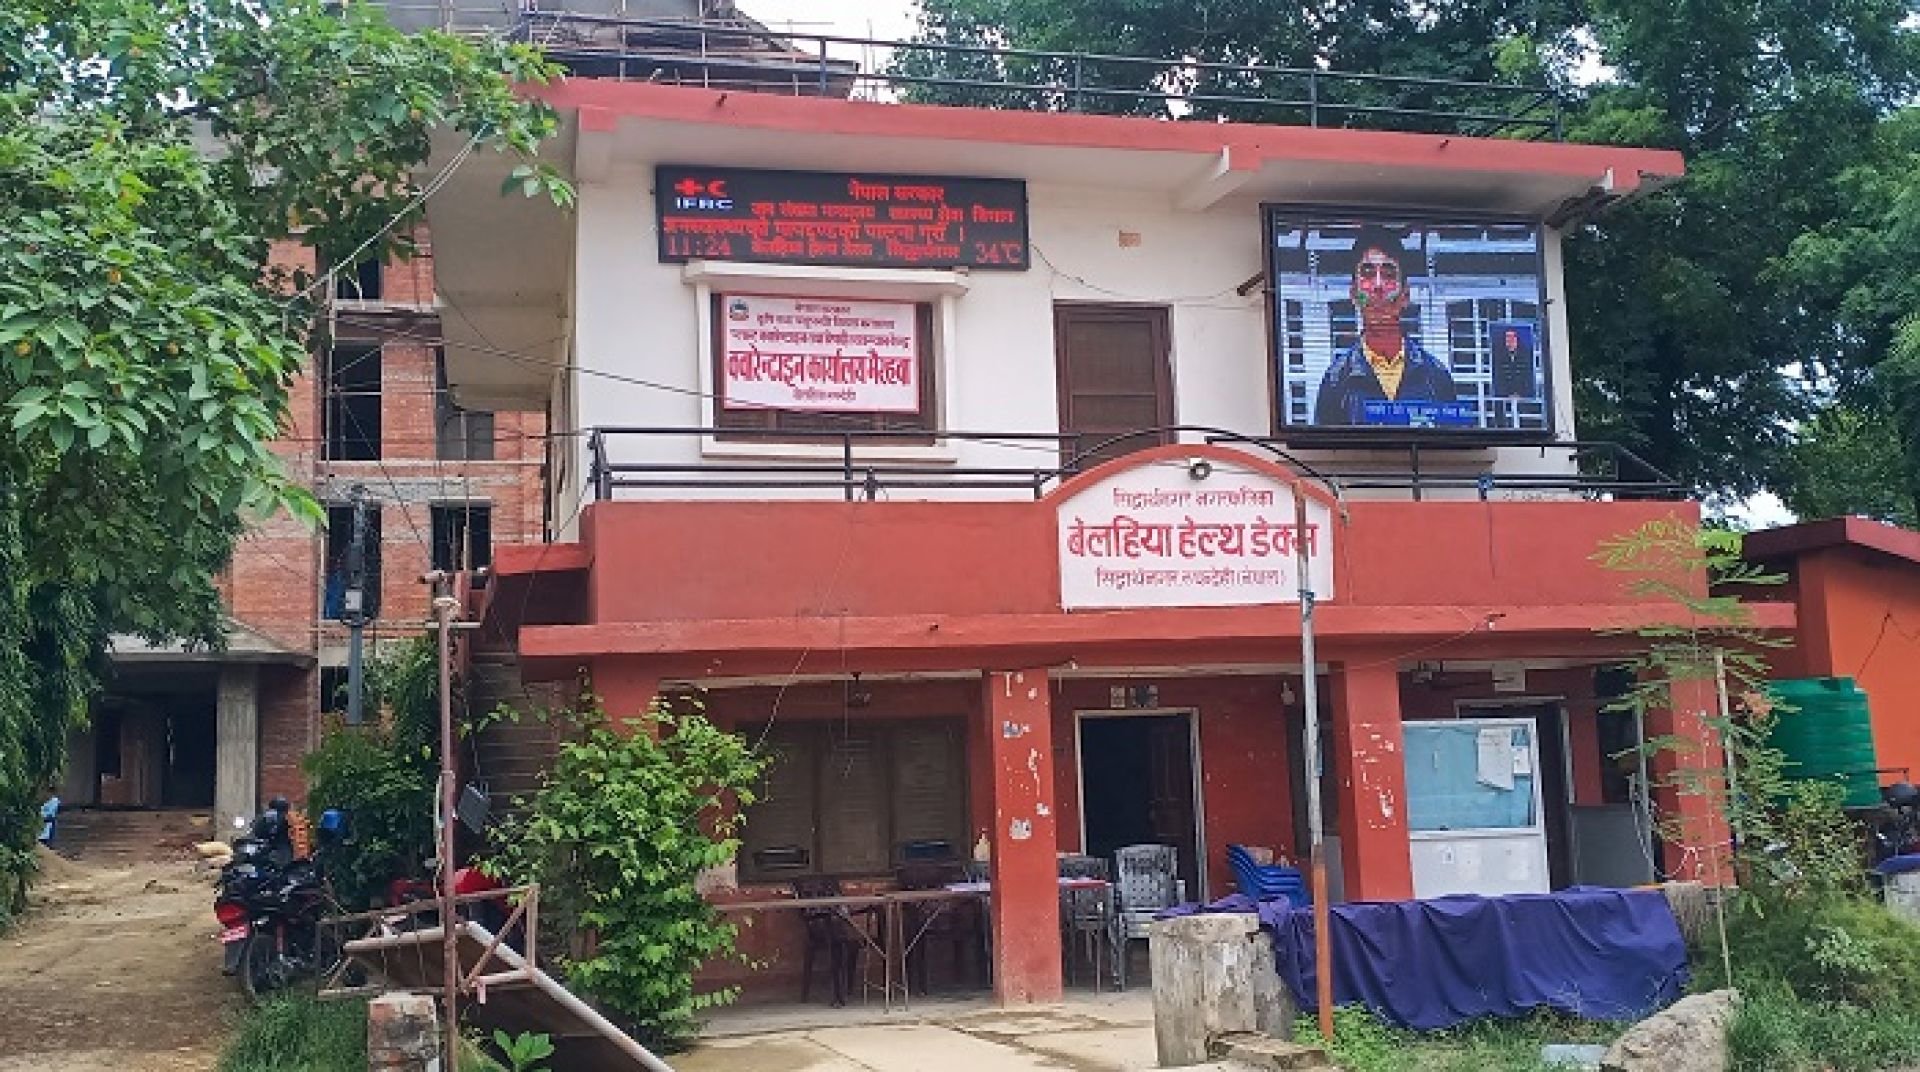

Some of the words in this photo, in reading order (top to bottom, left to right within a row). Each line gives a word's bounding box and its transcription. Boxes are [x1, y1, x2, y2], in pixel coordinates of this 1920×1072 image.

[675, 197, 733, 209] IFRC
[848, 178, 890, 200] नेपाल
[894, 186, 944, 203] सरकार
[668, 236, 732, 255] 11:24
[809, 348, 864, 384] कार्यालय
[1067, 516, 1173, 558] बेलहिया
[1177, 515, 1245, 558] हेल्थ
